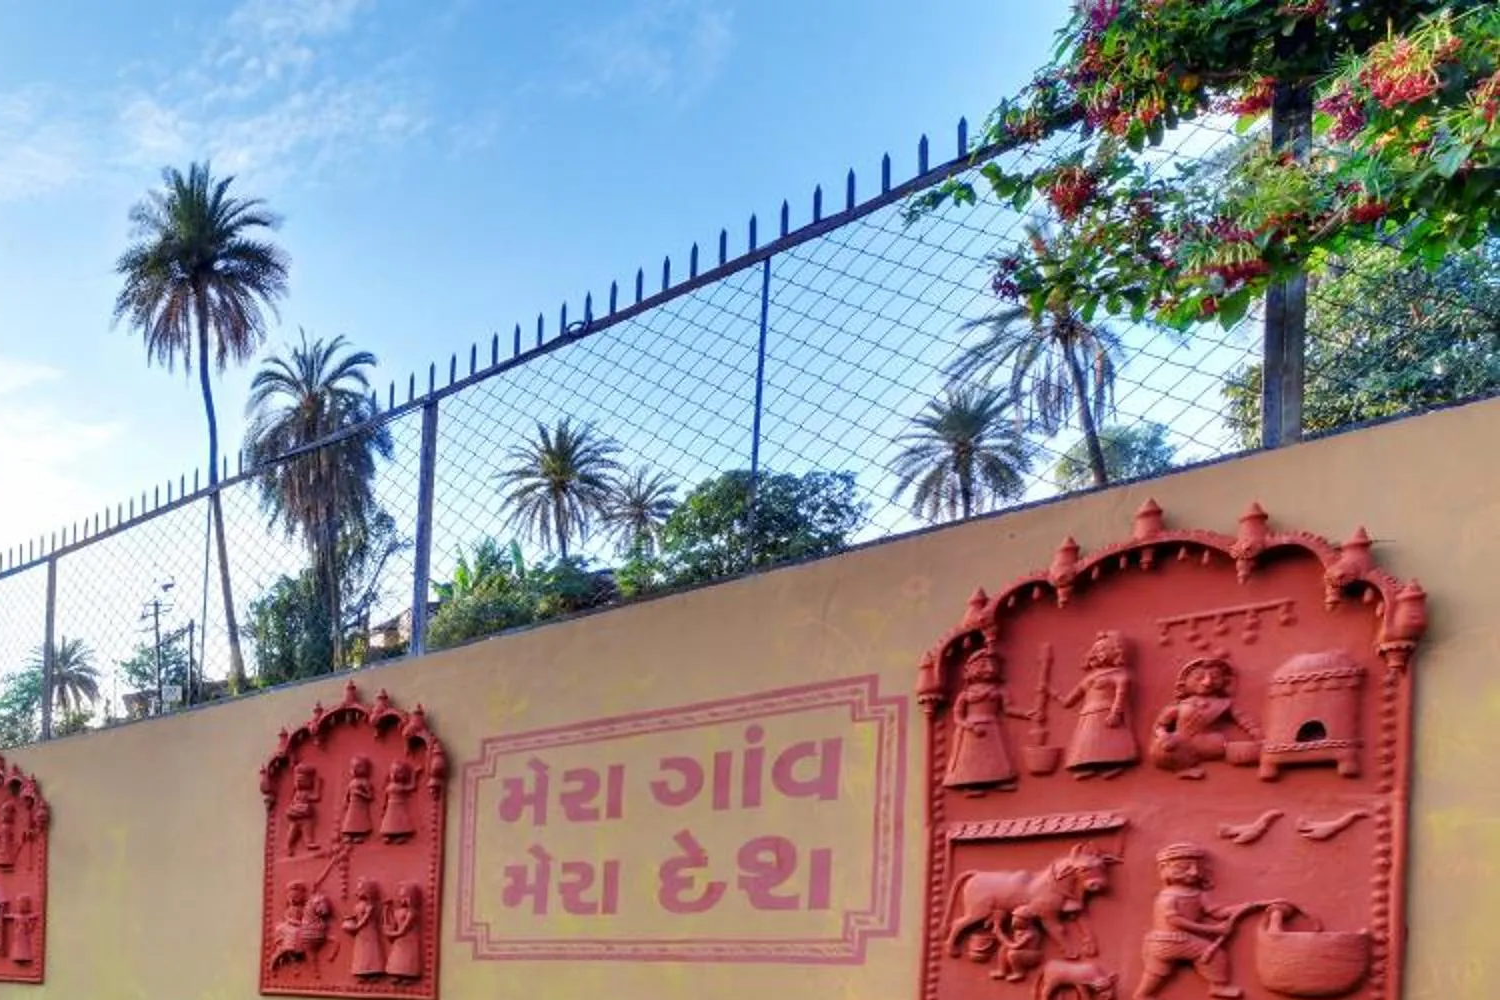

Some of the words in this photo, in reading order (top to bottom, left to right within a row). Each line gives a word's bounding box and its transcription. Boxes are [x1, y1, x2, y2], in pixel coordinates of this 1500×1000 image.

[500, 758, 624, 826] મેરા
[650, 724, 842, 811] ગાંવ
[502, 844, 620, 916] મેરા
[657, 829, 834, 915] દેશ
